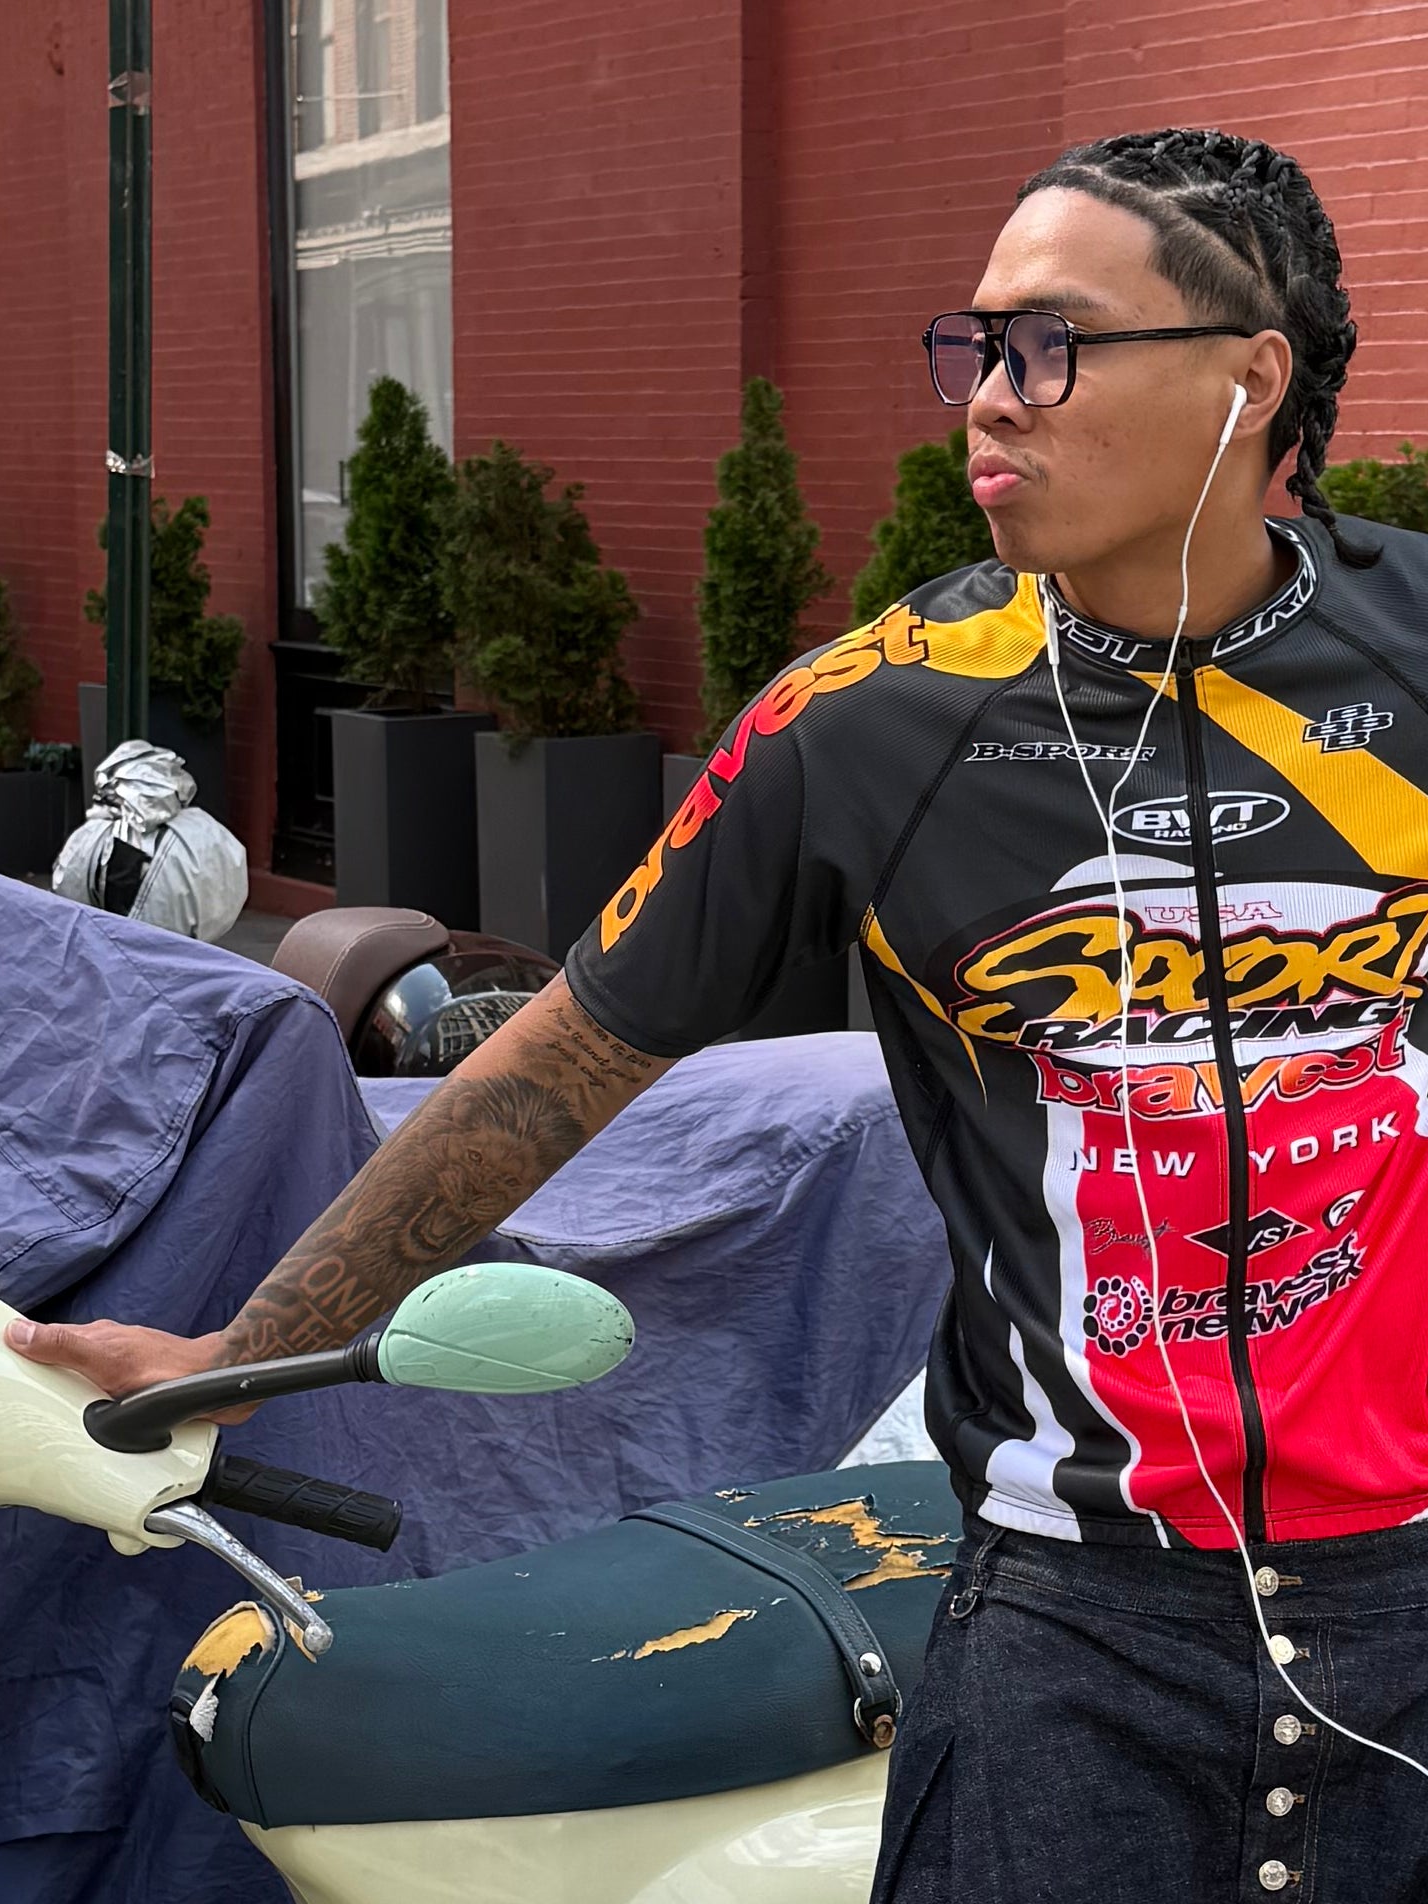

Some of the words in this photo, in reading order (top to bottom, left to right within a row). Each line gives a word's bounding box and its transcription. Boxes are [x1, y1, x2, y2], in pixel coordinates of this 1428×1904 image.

[600, 604, 926, 954] bravest
[1070, 1146, 1197, 1178] NEW
[1248, 1110, 1400, 1175] YORK
[299, 1255, 389, 1330] ONL
